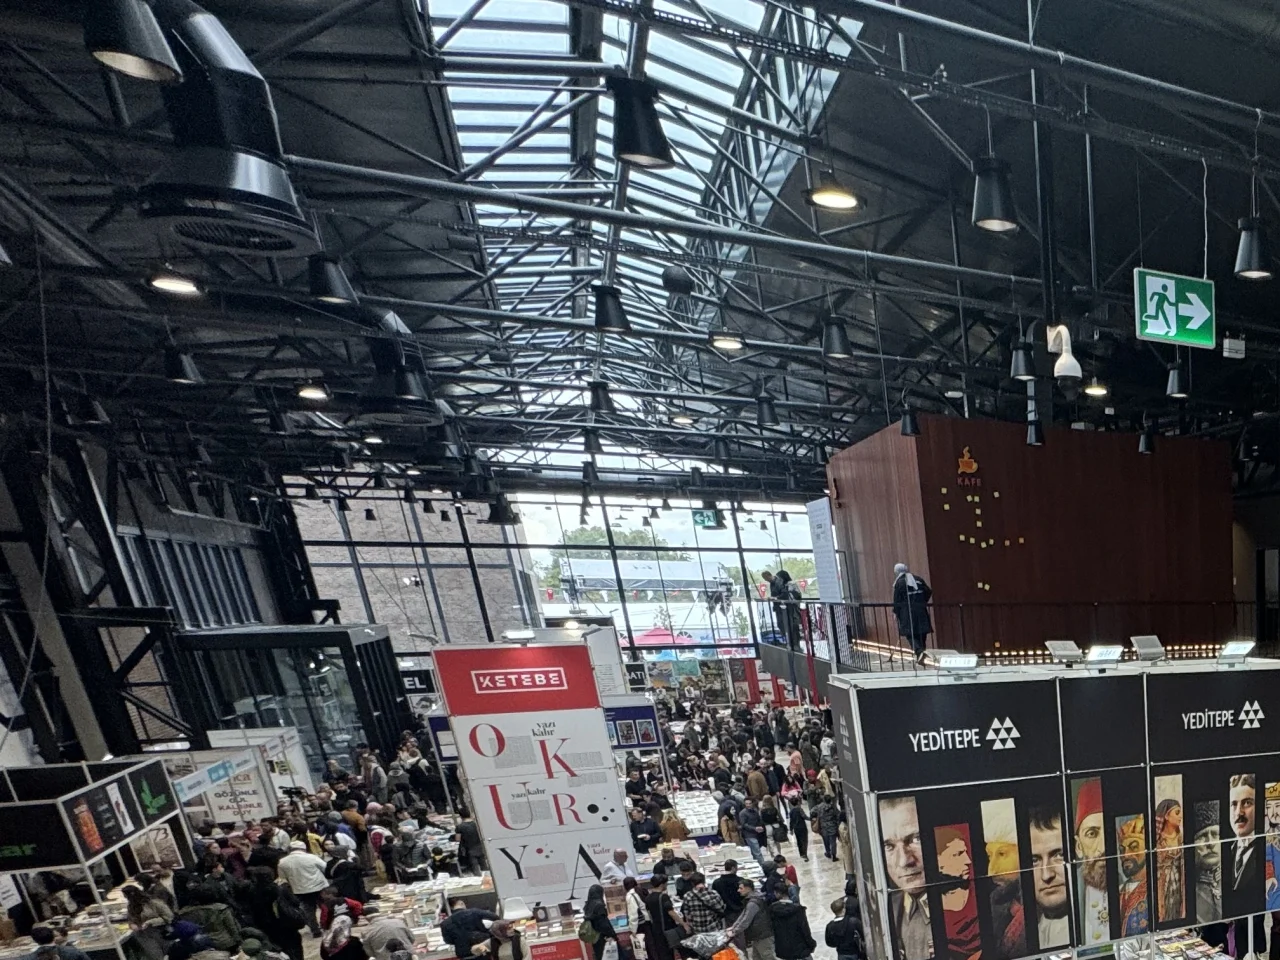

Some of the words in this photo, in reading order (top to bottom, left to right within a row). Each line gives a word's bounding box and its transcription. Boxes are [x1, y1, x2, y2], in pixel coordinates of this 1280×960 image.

[956, 477, 982, 487] KAFE
[479, 672, 561, 689] KETEBE
[1182, 708, 1235, 730] YEDİTEPE
[909, 728, 981, 752] YEDİTEPE
